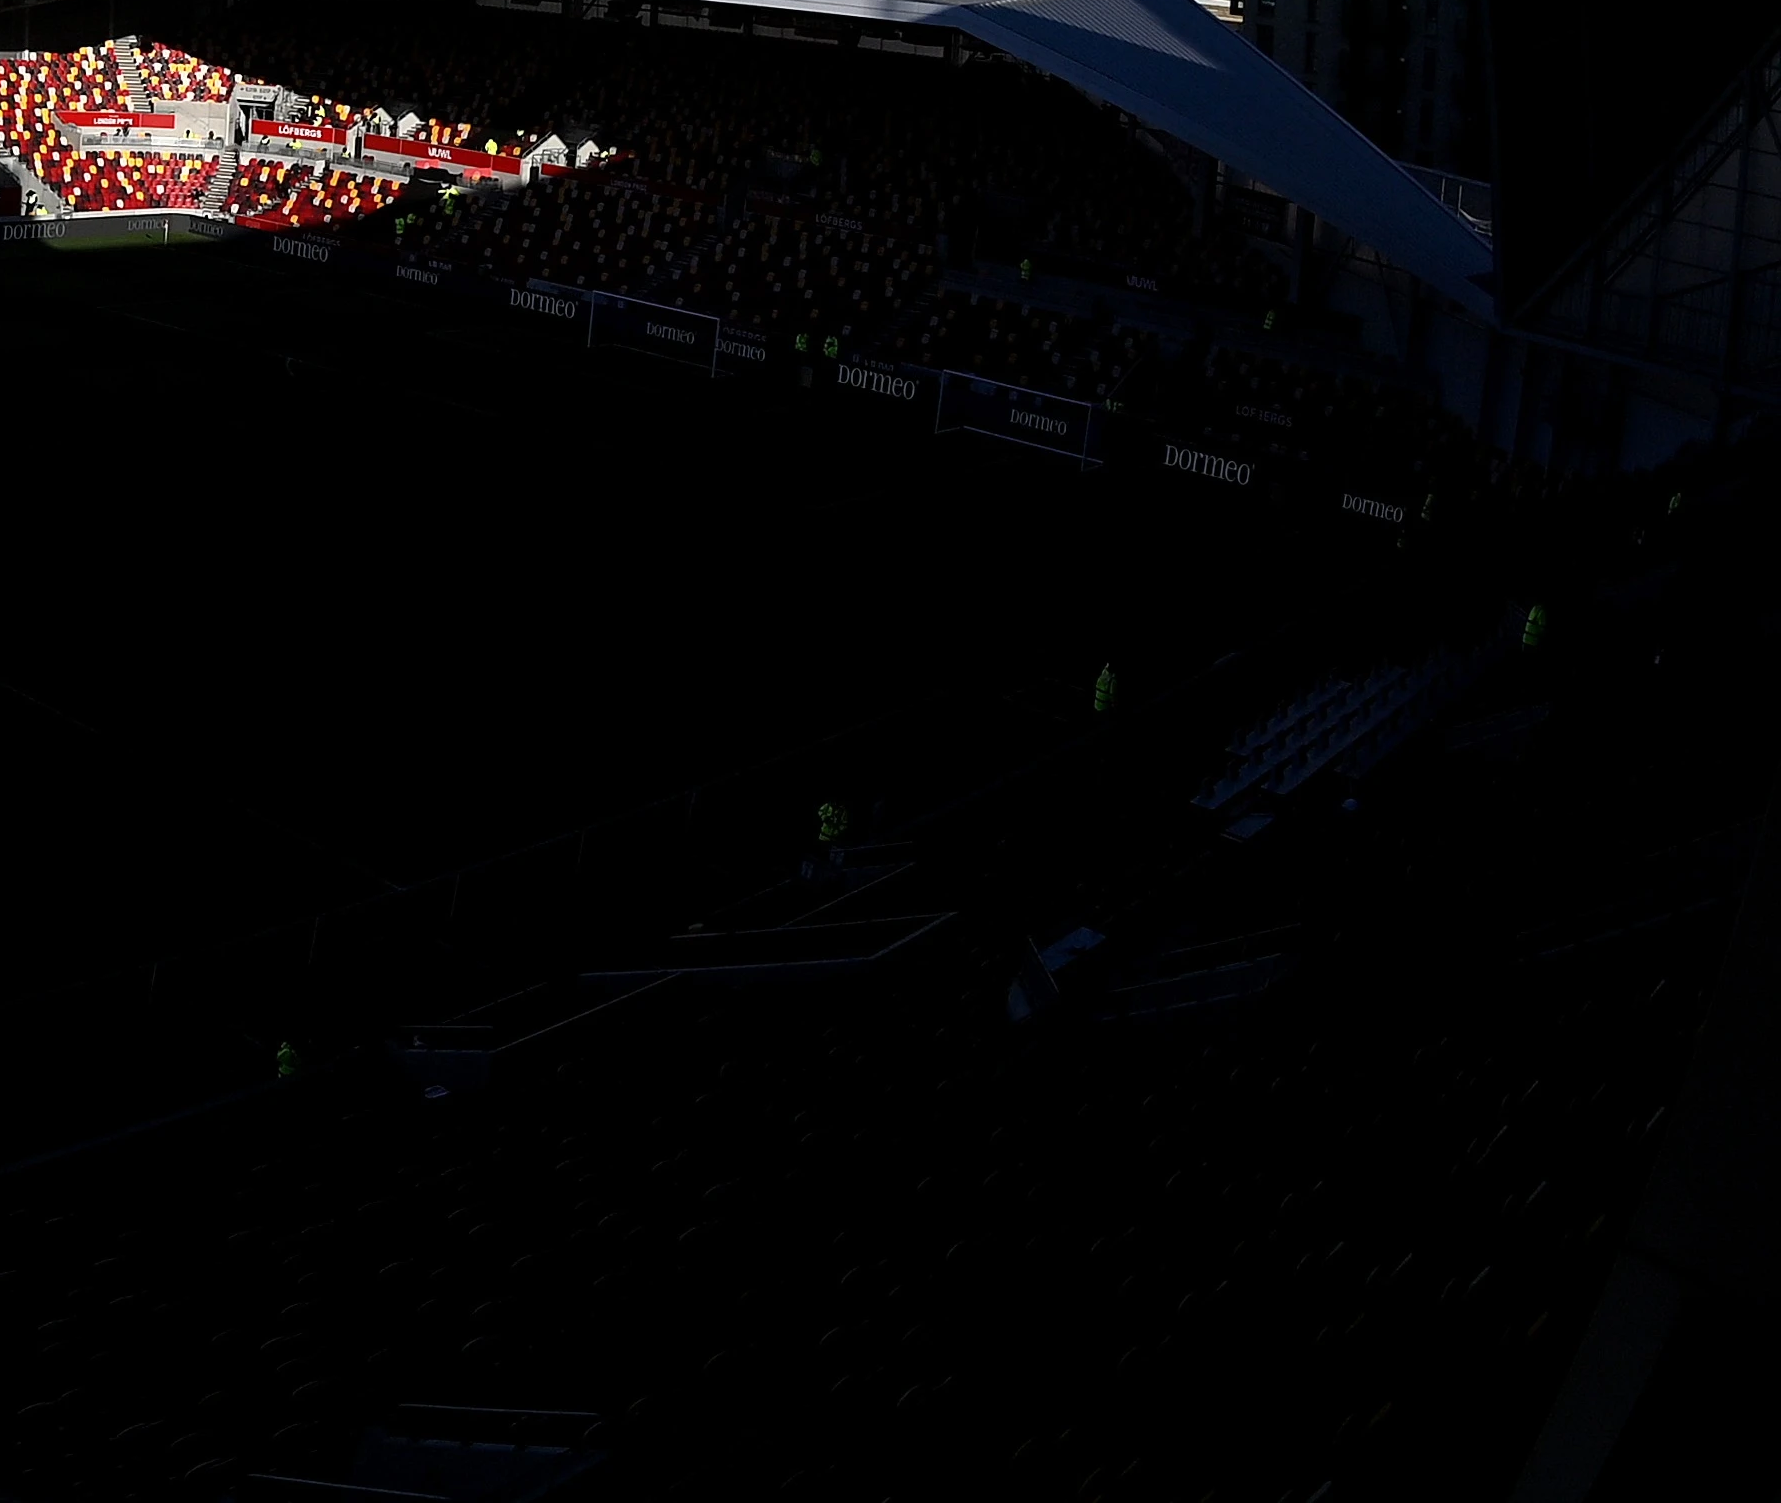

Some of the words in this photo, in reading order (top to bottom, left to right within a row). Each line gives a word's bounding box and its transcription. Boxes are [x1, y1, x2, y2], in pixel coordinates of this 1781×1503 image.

[278, 125, 323, 139] LÖFBERGS
[510, 288, 576, 319] Dormeo
[837, 363, 916, 400] Dormeo
[1162, 444, 1250, 486] Dormeo
[1341, 493, 1403, 523] Dormeo
